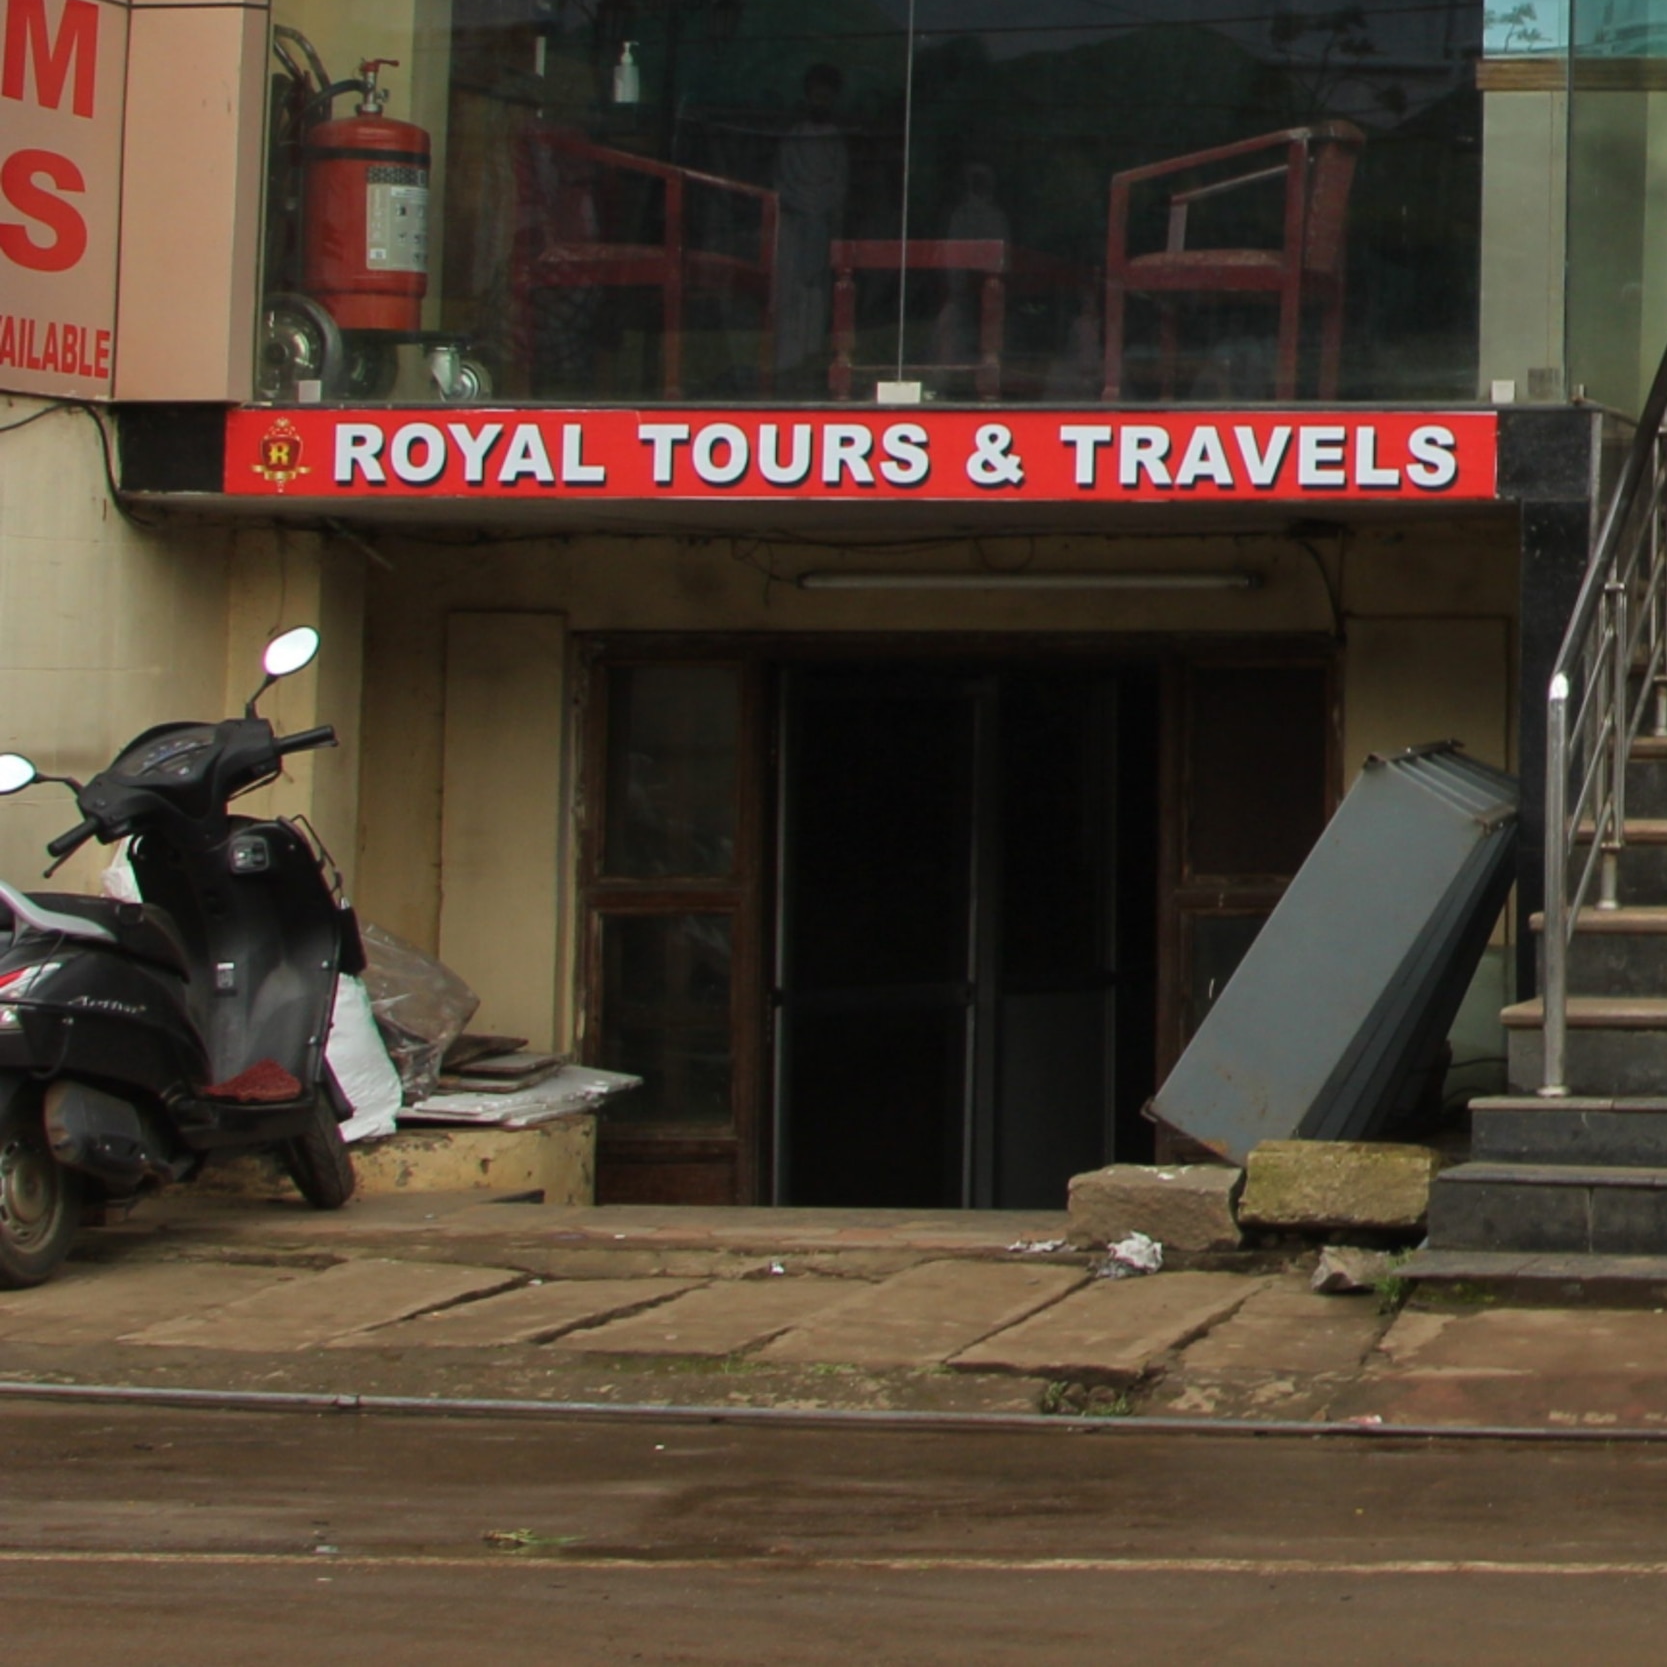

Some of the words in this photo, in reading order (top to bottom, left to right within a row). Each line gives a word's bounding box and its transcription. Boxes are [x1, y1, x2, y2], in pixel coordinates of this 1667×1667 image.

[333, 422, 605, 486] ROYAL
[638, 422, 932, 485] TOURS
[966, 423, 1025, 486] &
[1060, 423, 1458, 489] TRAVELS
